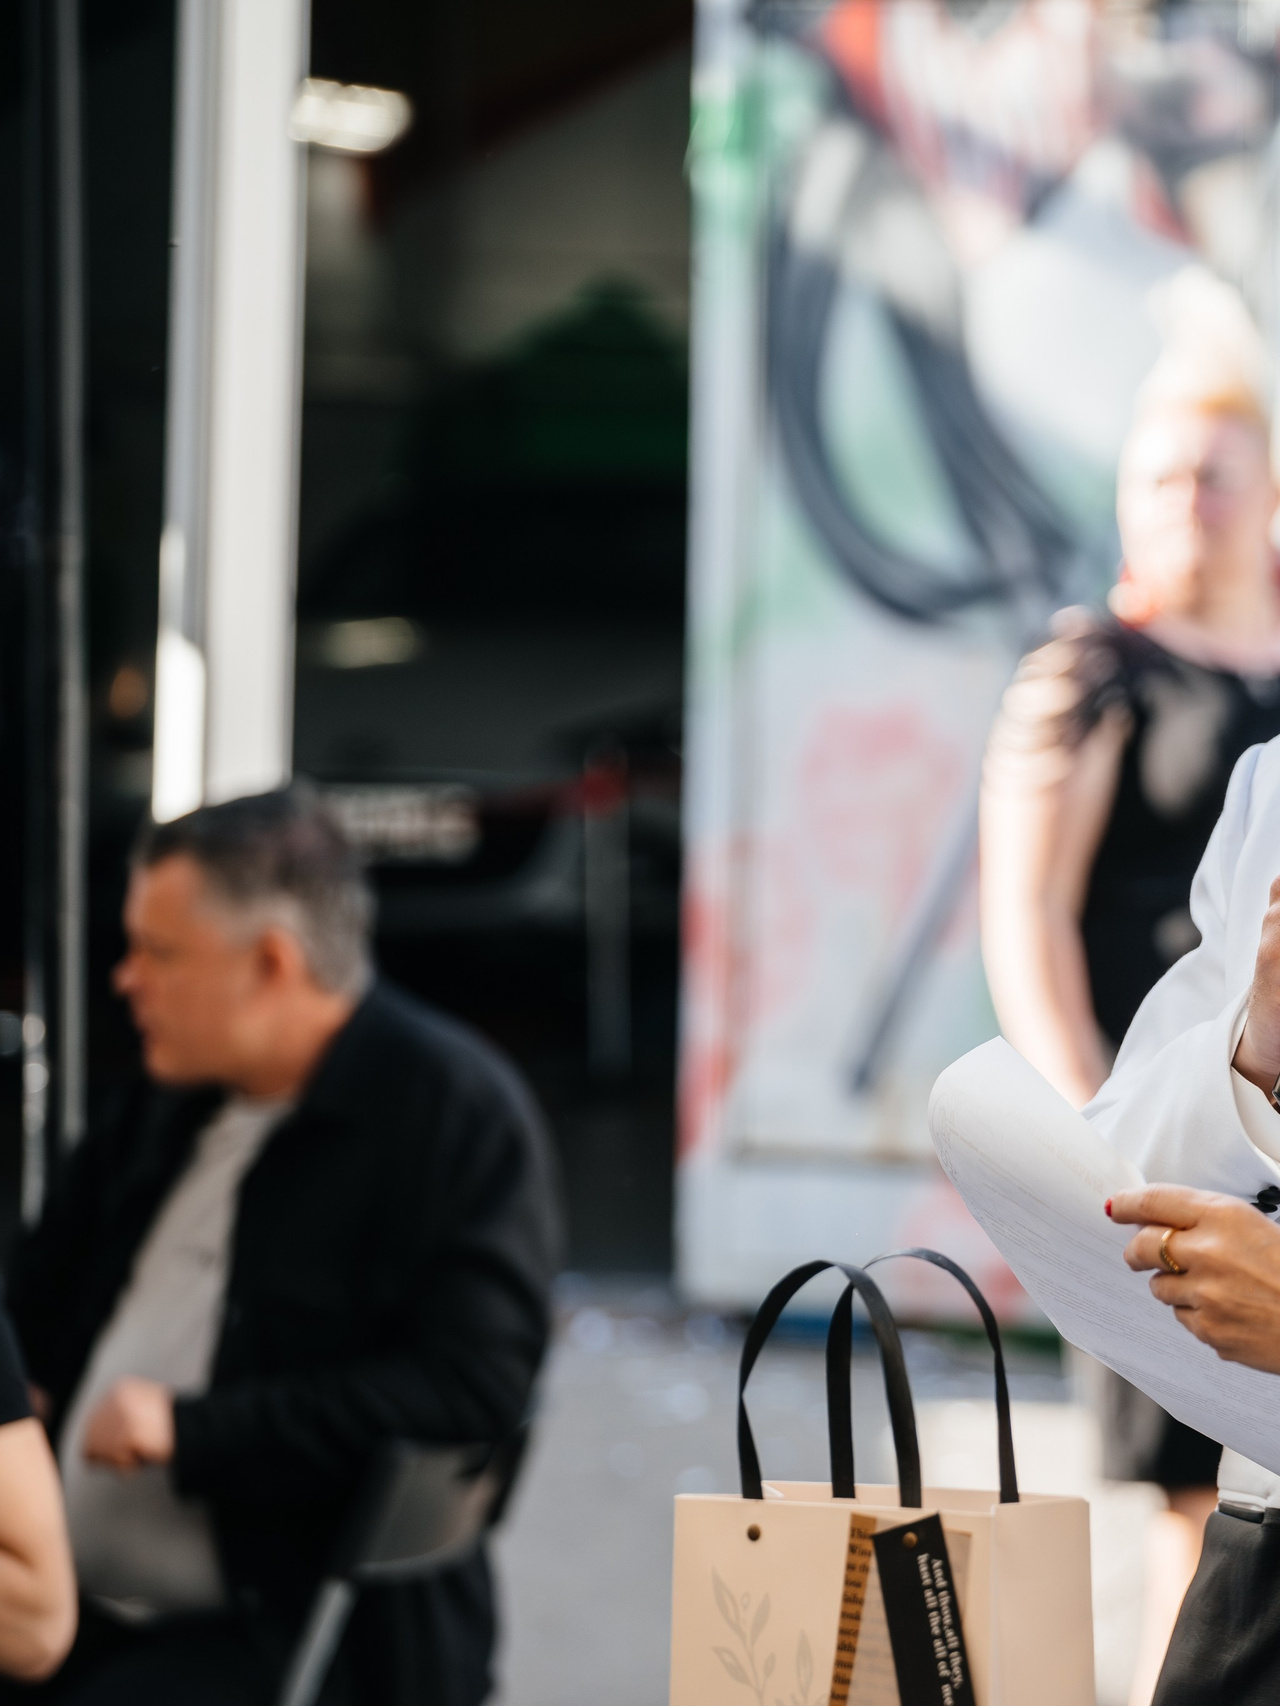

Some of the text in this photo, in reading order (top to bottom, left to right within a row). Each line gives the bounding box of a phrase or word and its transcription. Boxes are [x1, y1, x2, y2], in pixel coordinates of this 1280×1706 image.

[917, 1553, 932, 1587] hast
[931, 1558, 948, 1589] And
[924, 1588, 938, 1609] all
[928, 1610, 941, 1636] the
[933, 1638, 948, 1659] all
[937, 1661, 952, 1677] of
